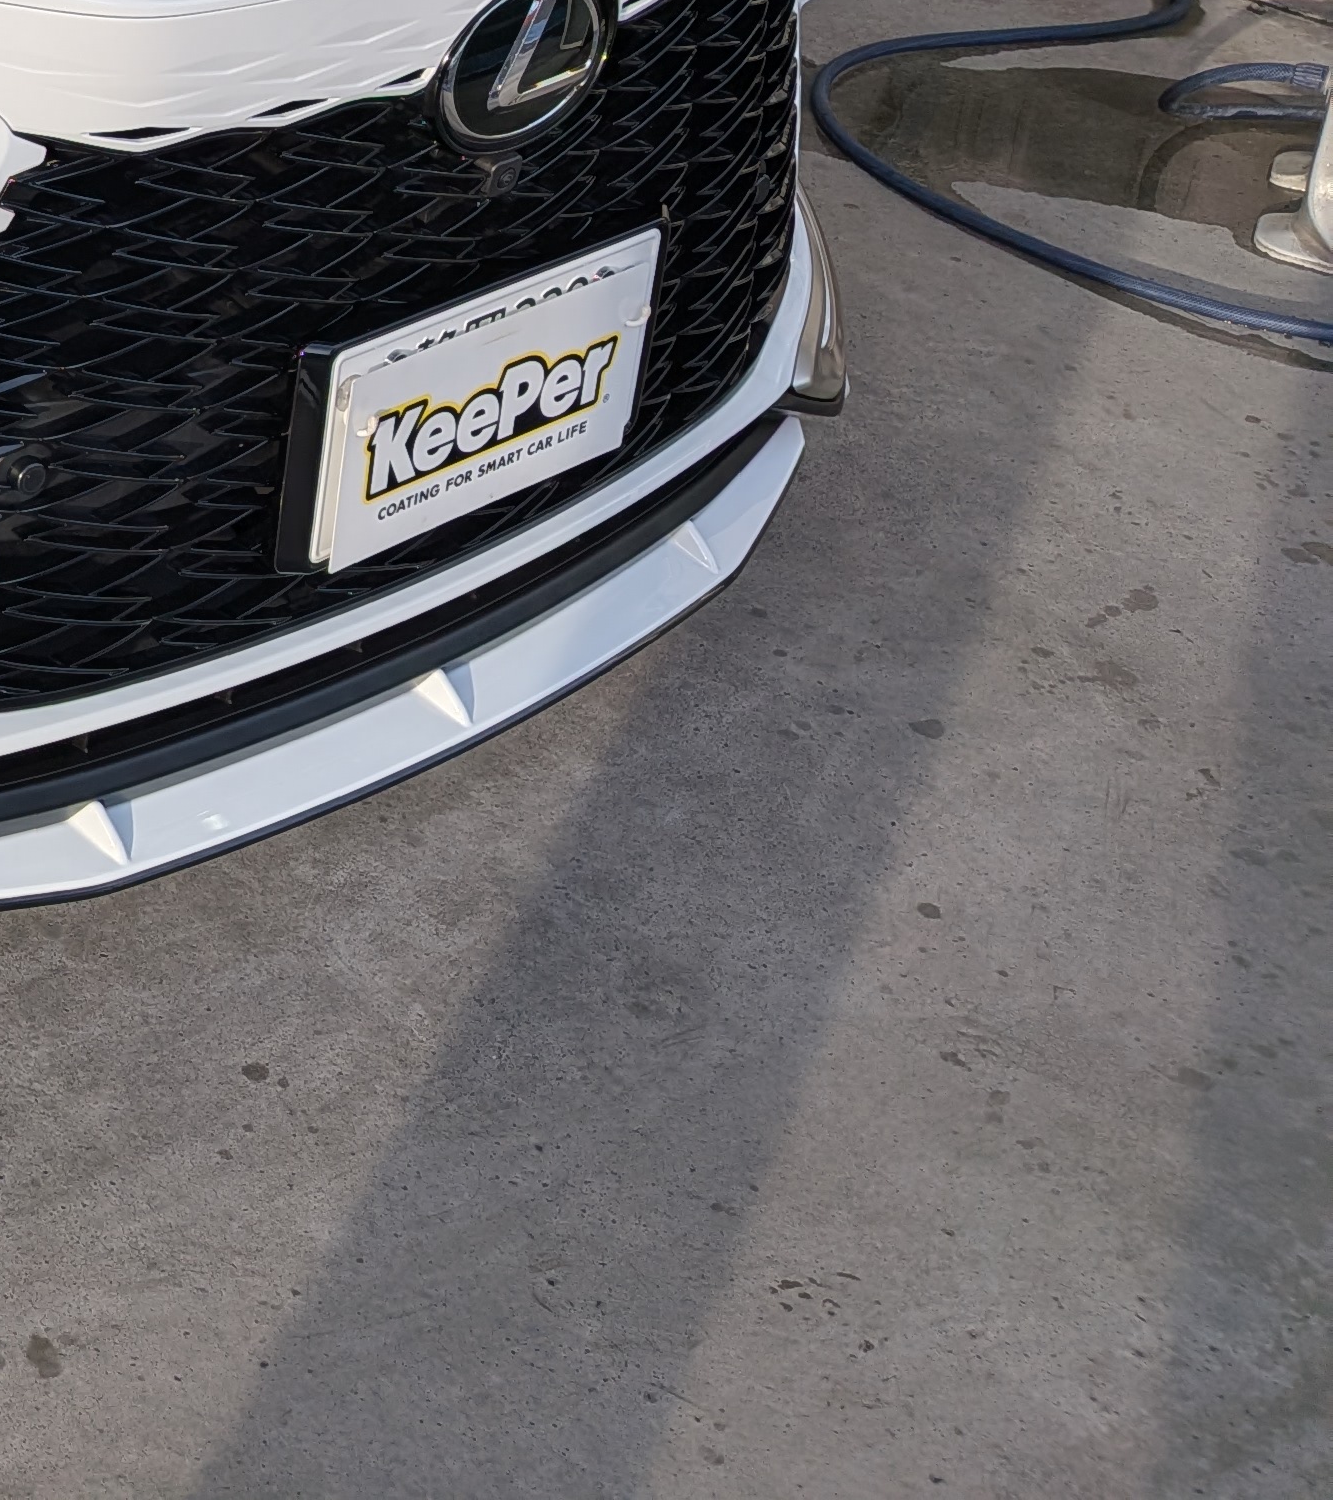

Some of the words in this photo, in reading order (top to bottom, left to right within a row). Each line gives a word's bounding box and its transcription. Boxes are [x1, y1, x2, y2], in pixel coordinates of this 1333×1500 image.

[365, 334, 619, 502] KeePer
[376, 484, 441, 521] COATING
[445, 470, 473, 492] FOR
[477, 448, 523, 478] SMART
[526, 435, 553, 456] CAR
[557, 420, 588, 444] LIFE
